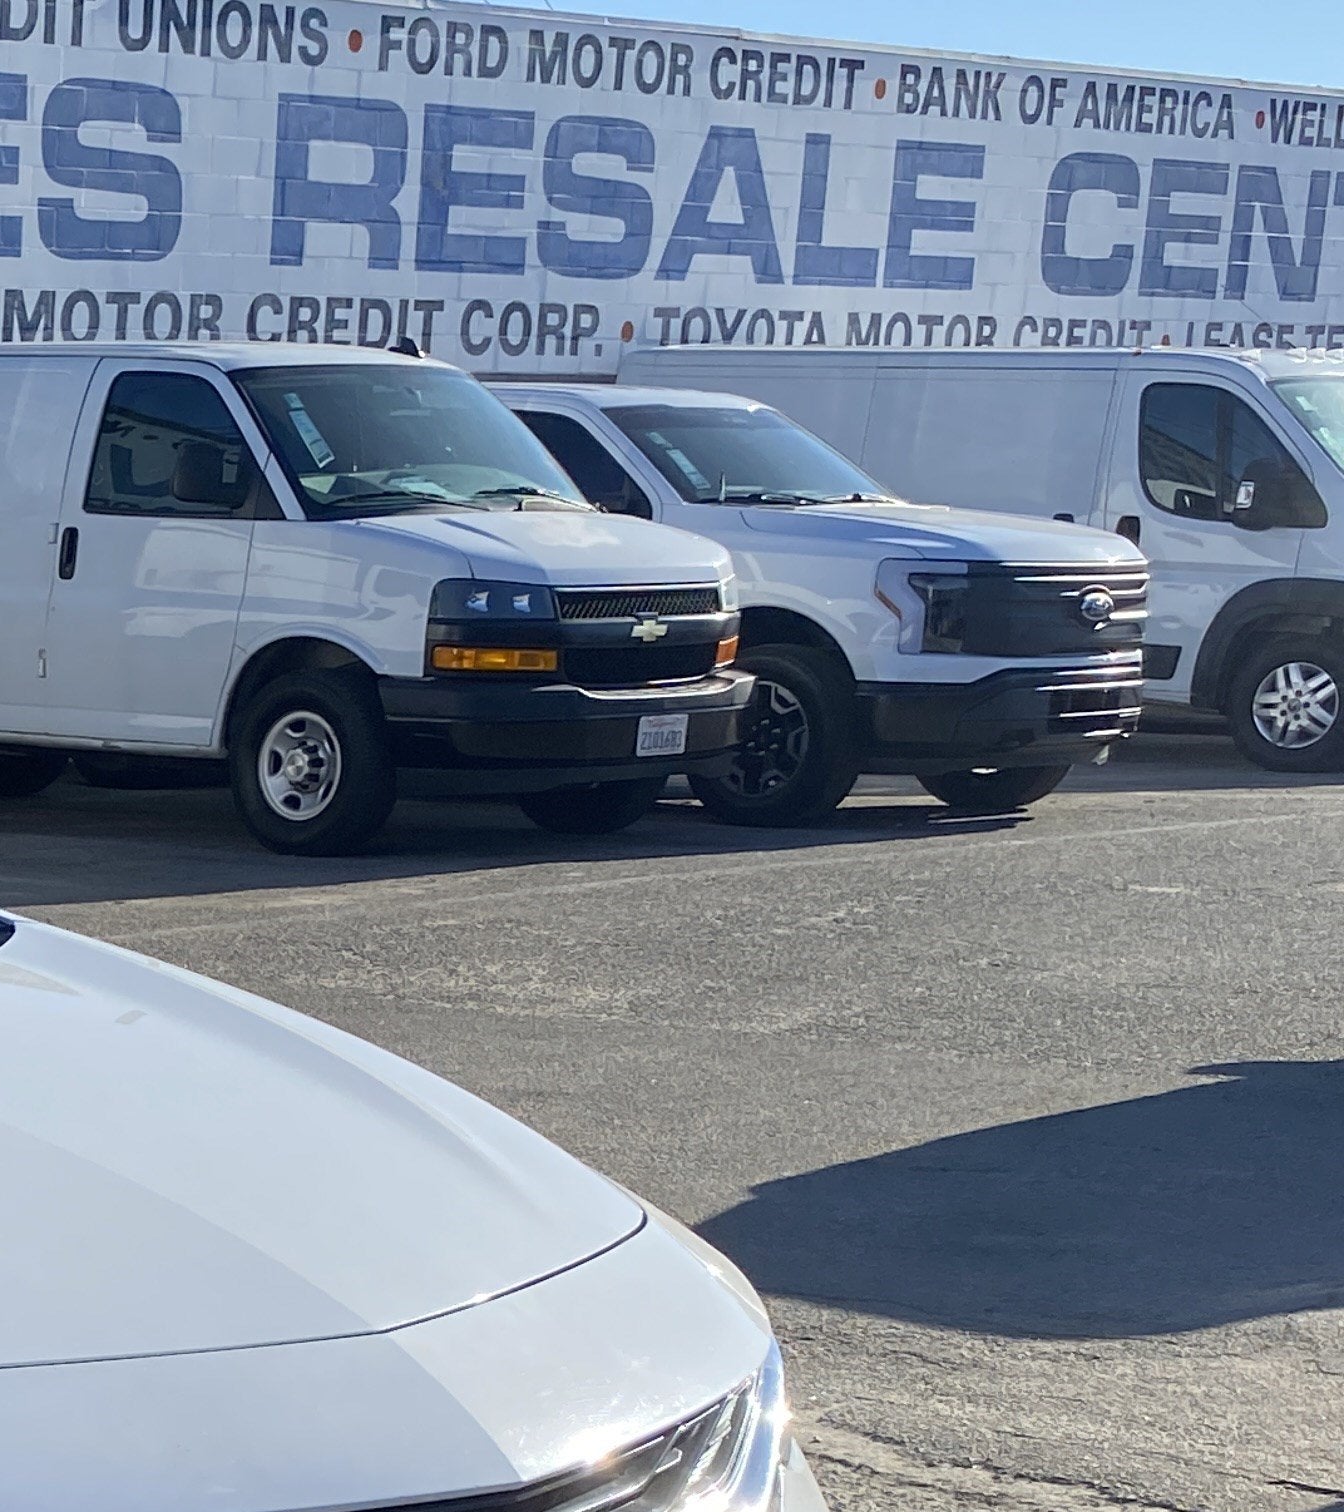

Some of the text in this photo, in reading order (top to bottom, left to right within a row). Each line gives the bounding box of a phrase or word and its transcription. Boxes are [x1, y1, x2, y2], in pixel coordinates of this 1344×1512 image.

[117, 0, 330, 67] UNIONS
[378, 14, 508, 79] FORD
[525, 28, 695, 98] MOTOR
[710, 46, 866, 111] CREDIT
[897, 63, 1007, 123] BANK
[1019, 74, 1068, 128] OF
[1073, 80, 1235, 140] AMERICA
[269, 92, 986, 291] RESALE
[1, 288, 222, 342] MOTOR
[246, 292, 445, 354] CREDIT
[460, 299, 603, 358] CORP.
[653, 306, 826, 346] TOYOTA
[845, 311, 998, 347] MOTOR
[1013, 315, 1152, 348] CREDIT
